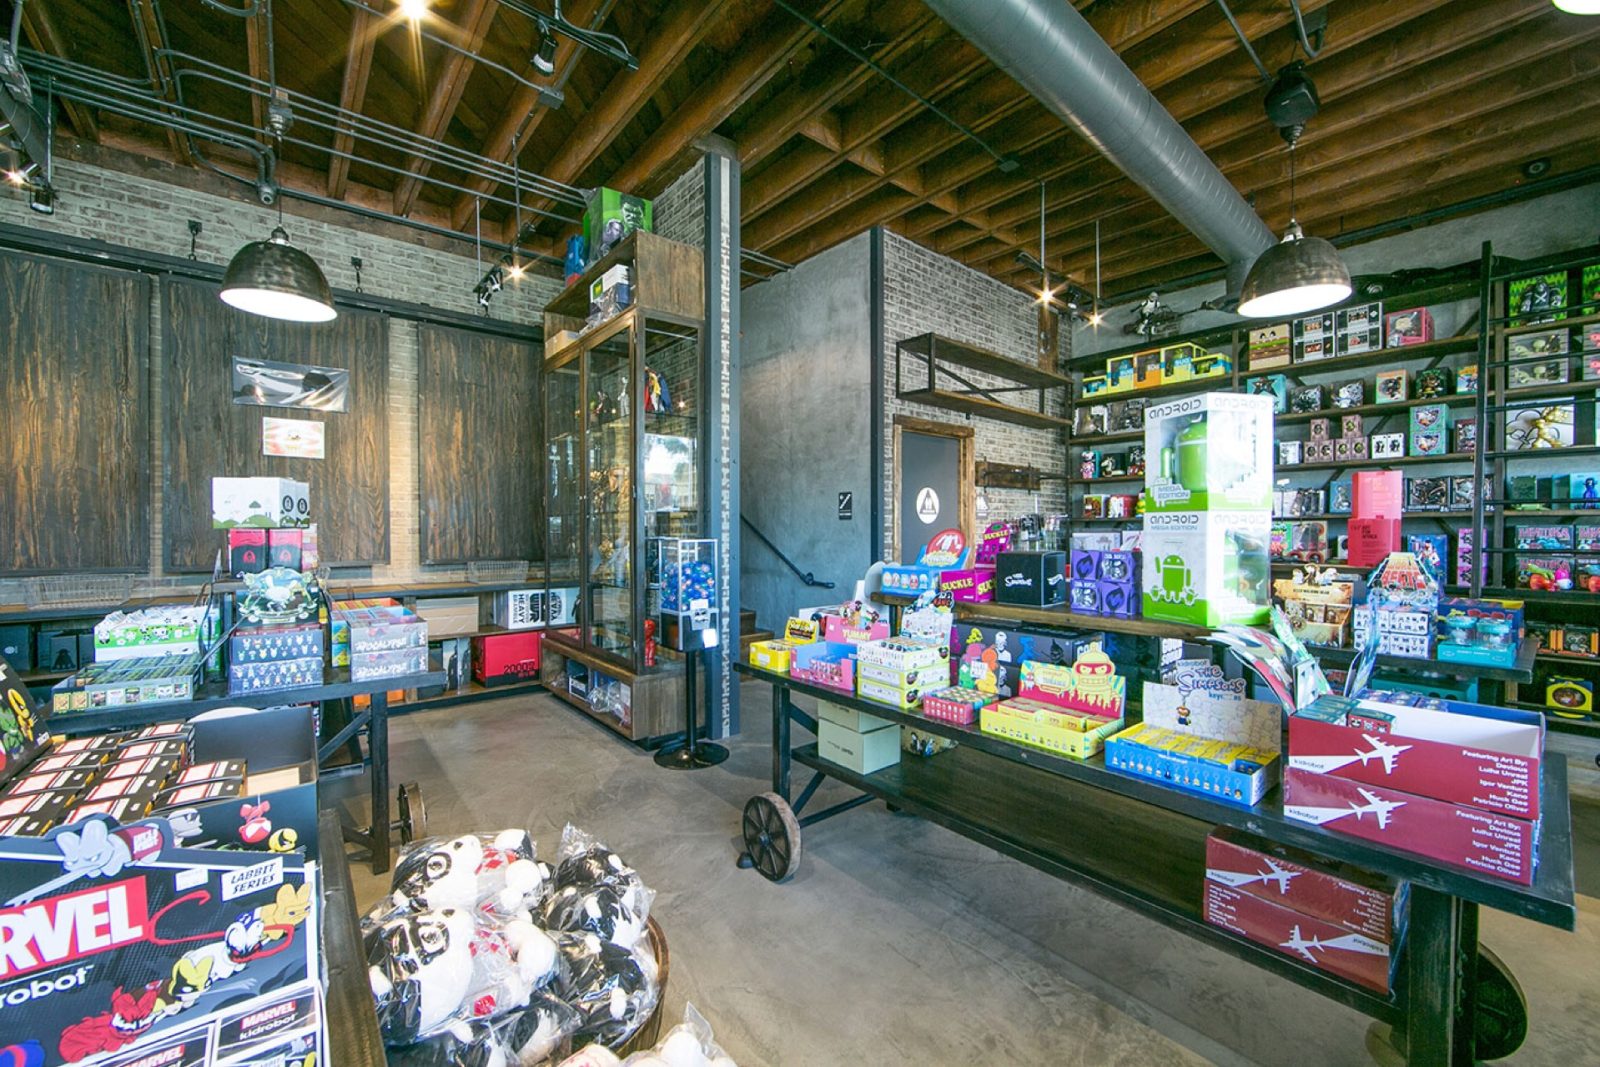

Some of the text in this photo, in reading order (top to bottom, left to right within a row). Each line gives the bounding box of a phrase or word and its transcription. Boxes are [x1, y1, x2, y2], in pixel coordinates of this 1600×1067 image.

[1149, 399, 1202, 419] ANDROID
[1158, 491, 1189, 499] EDITION
[1150, 514, 1199, 525] ANDROID
[984, 529, 1009, 541] SUCKLE
[941, 577, 974, 591] SUCKLE
[1462, 750, 1499, 762] Featuring
[1500, 757, 1513, 765] Art
[1480, 779, 1528, 793] Igor Ventura
[1511, 779, 1528, 787] JPK
[1504, 803, 1528, 813] Oliver
[1456, 810, 1492, 823] Featuring
[1494, 819, 1506, 827] Art
[1472, 840, 1521, 857] Igor Ventura
[1504, 842, 1521, 850] JPK
[231, 862, 277, 884] LABBIT
[1497, 866, 1520, 877] Oliver
[232, 873, 275, 895] SERIES
[0, 885, 143, 976] RVEL
[241, 1000, 297, 1030] MARVEL
[240, 1012, 299, 1040] kidrobot
